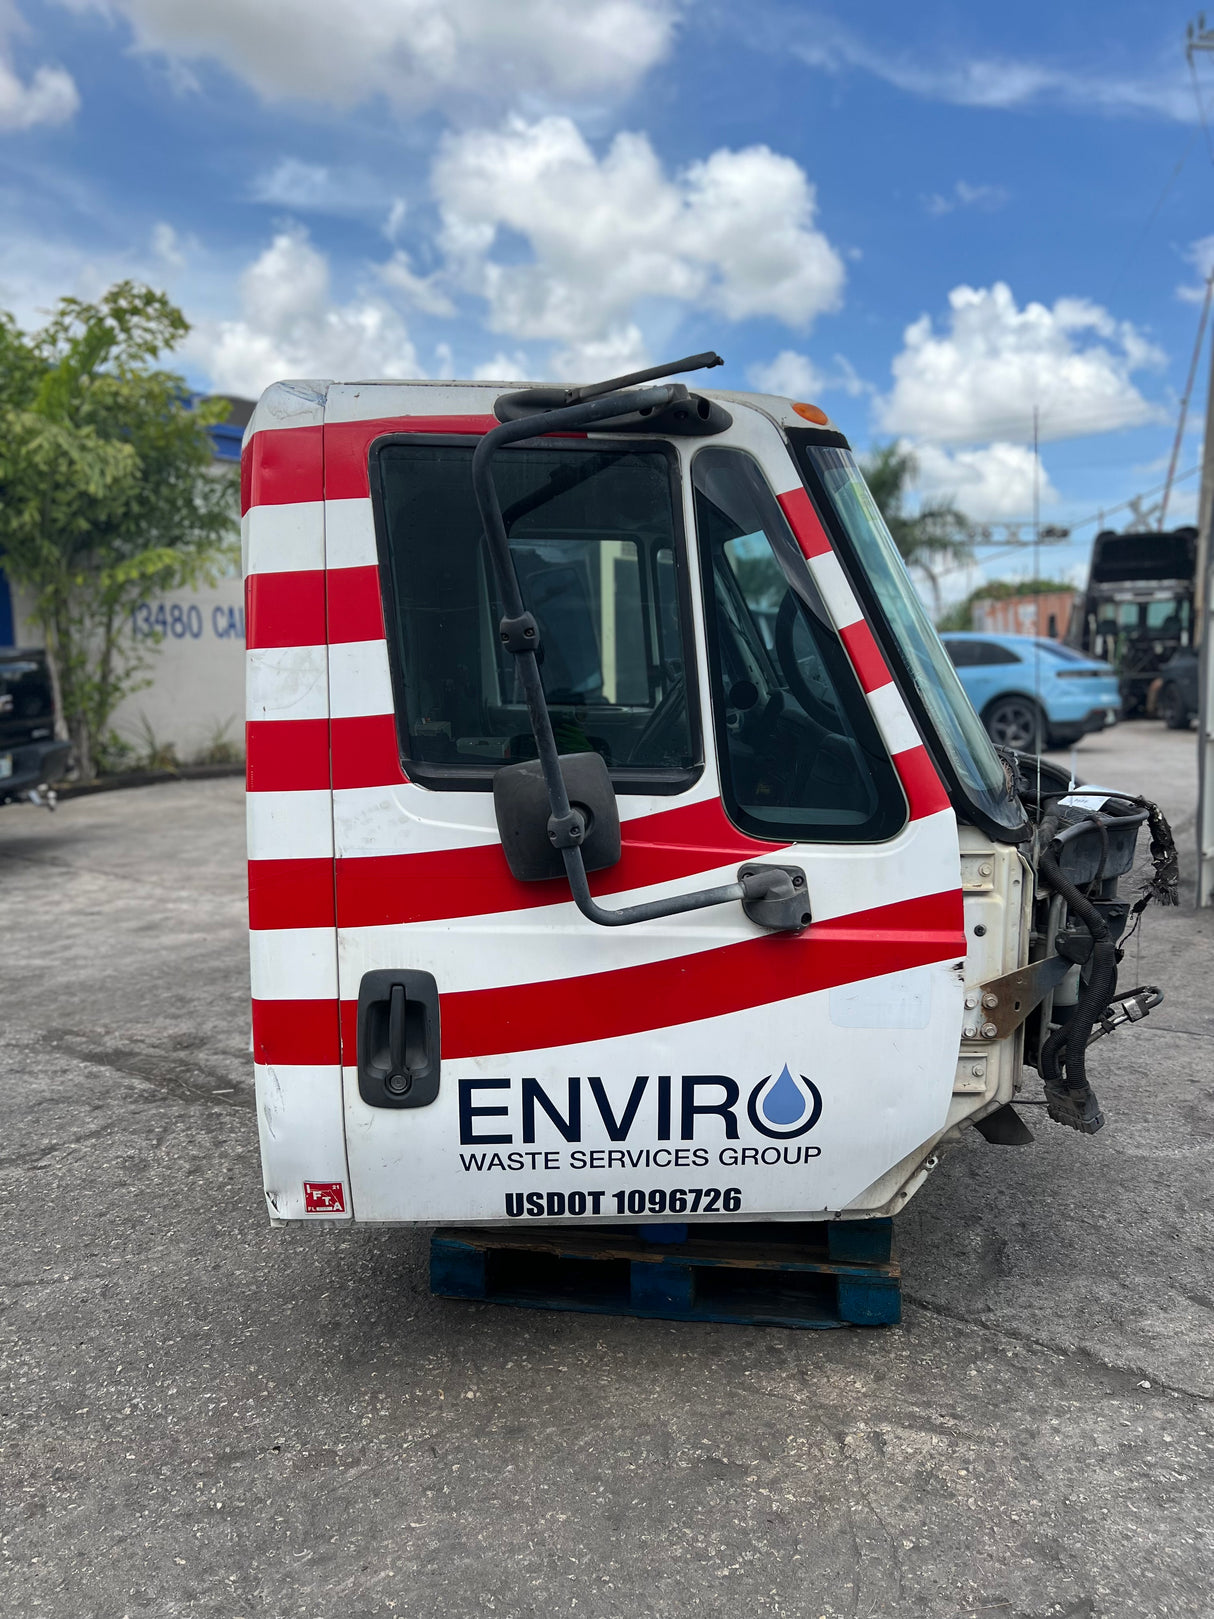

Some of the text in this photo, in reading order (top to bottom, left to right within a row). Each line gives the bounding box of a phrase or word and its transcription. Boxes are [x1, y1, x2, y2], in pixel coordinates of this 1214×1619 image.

[131, 602, 203, 640] 13480
[457, 1063, 823, 1146] ENVIRO
[459, 1146, 822, 1172] WASTE SERVICES GROUP
[505, 1187, 742, 1218] USDOT 1096726
